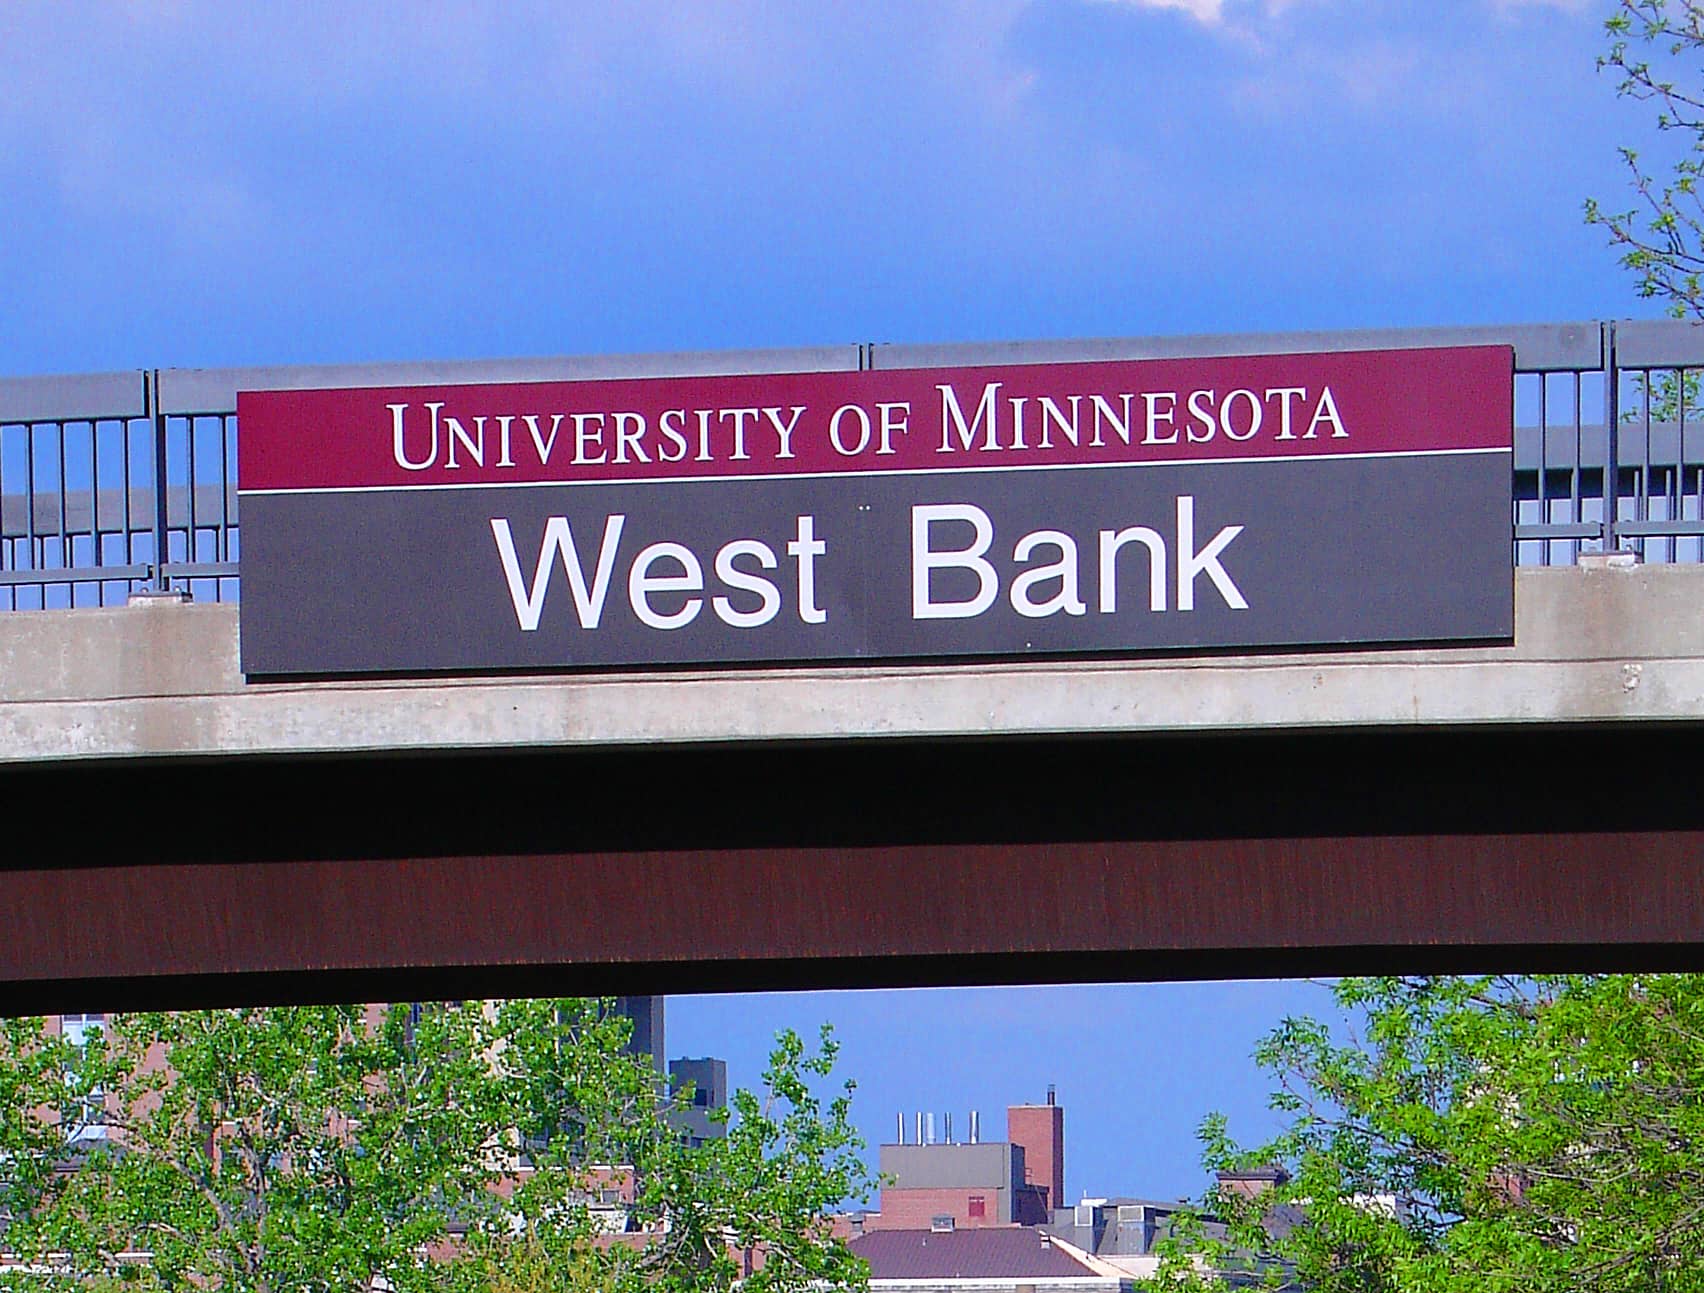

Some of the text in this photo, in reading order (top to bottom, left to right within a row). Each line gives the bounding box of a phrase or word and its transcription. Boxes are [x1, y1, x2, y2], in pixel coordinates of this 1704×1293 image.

[385, 382, 1350, 470] UNIVERSITY OF MINNESOTA
[490, 495, 1250, 631] West Bank
